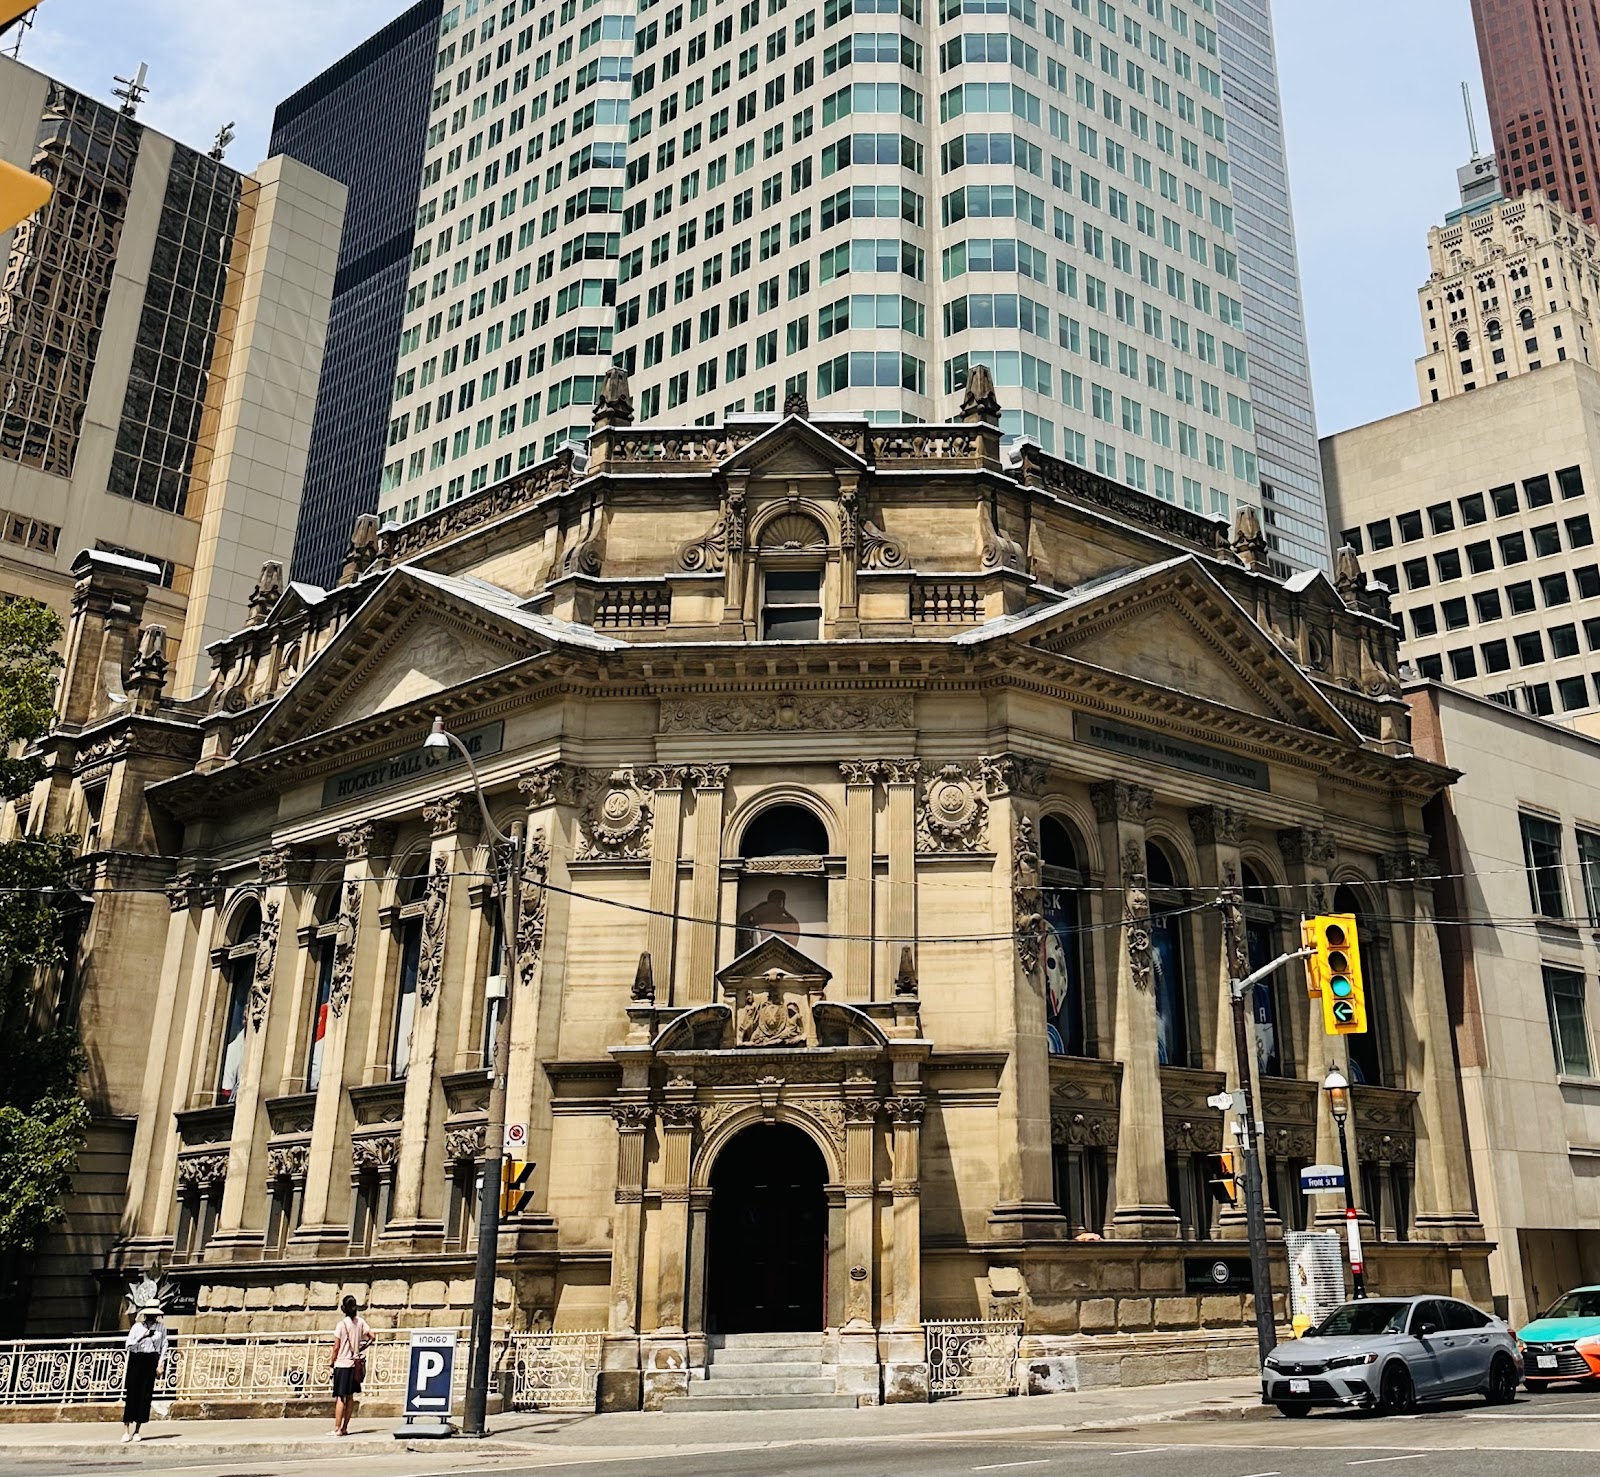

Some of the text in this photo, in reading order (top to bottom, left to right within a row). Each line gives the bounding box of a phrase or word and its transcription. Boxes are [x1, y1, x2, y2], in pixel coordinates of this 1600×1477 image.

[1475, 159, 1498, 175] ST
[337, 766, 387, 797] HOCKEY
[389, 755, 422, 780] HALL
[1308, 1177, 1324, 1187] Front
[416, 1350, 445, 1391] P
